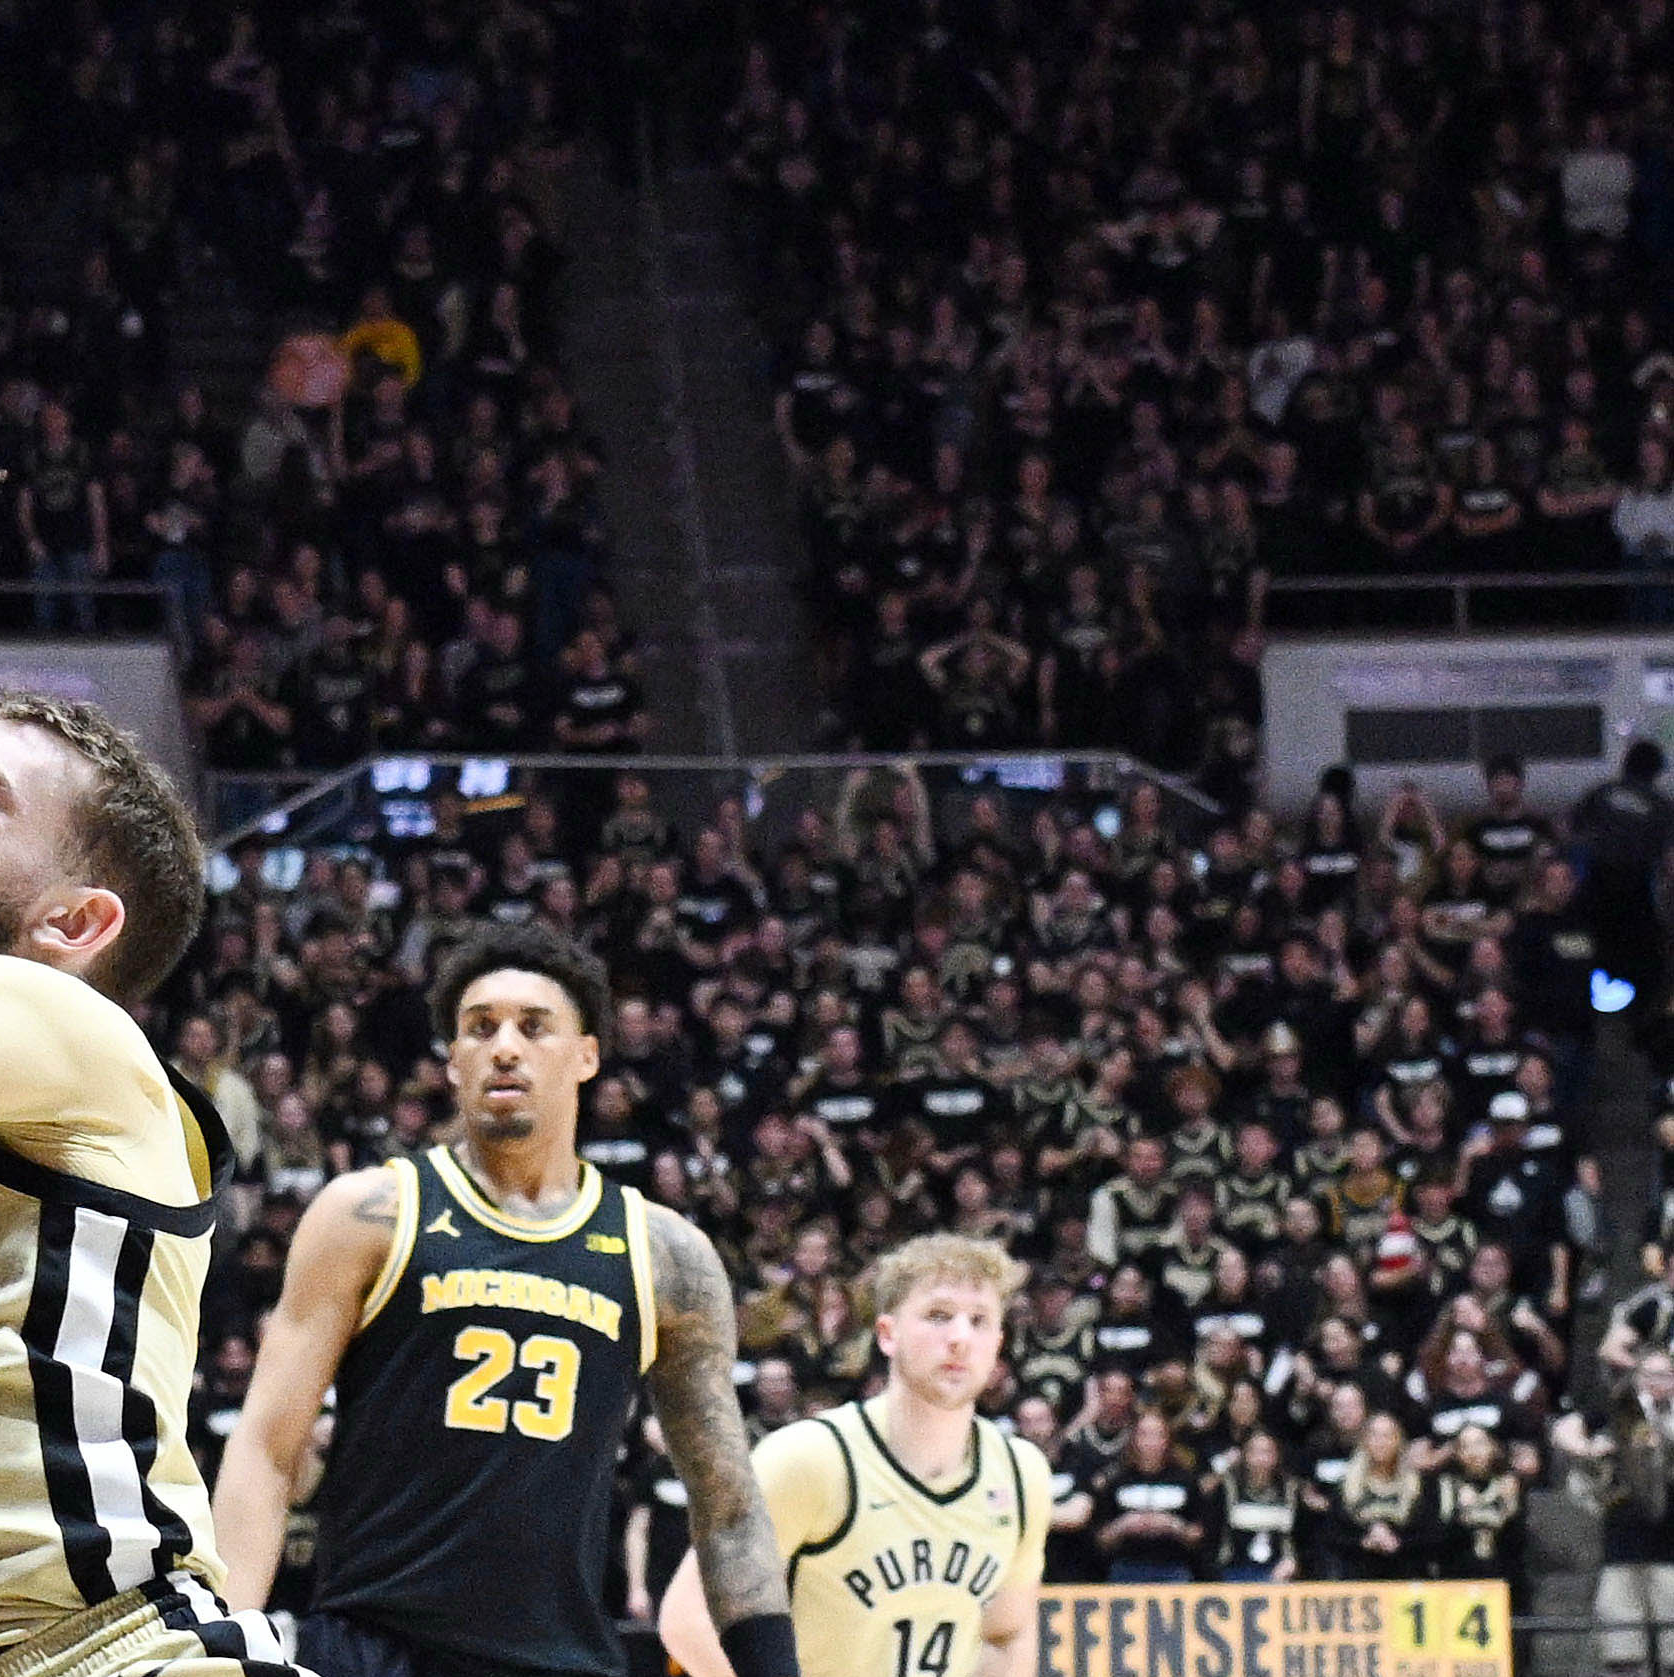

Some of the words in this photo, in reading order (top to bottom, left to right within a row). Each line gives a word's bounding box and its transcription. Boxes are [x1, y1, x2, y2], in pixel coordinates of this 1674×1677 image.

[421, 1268, 622, 1343] MICHIGAN
[445, 1326, 581, 1441] 23
[1281, 1596, 1383, 1634] LIVES
